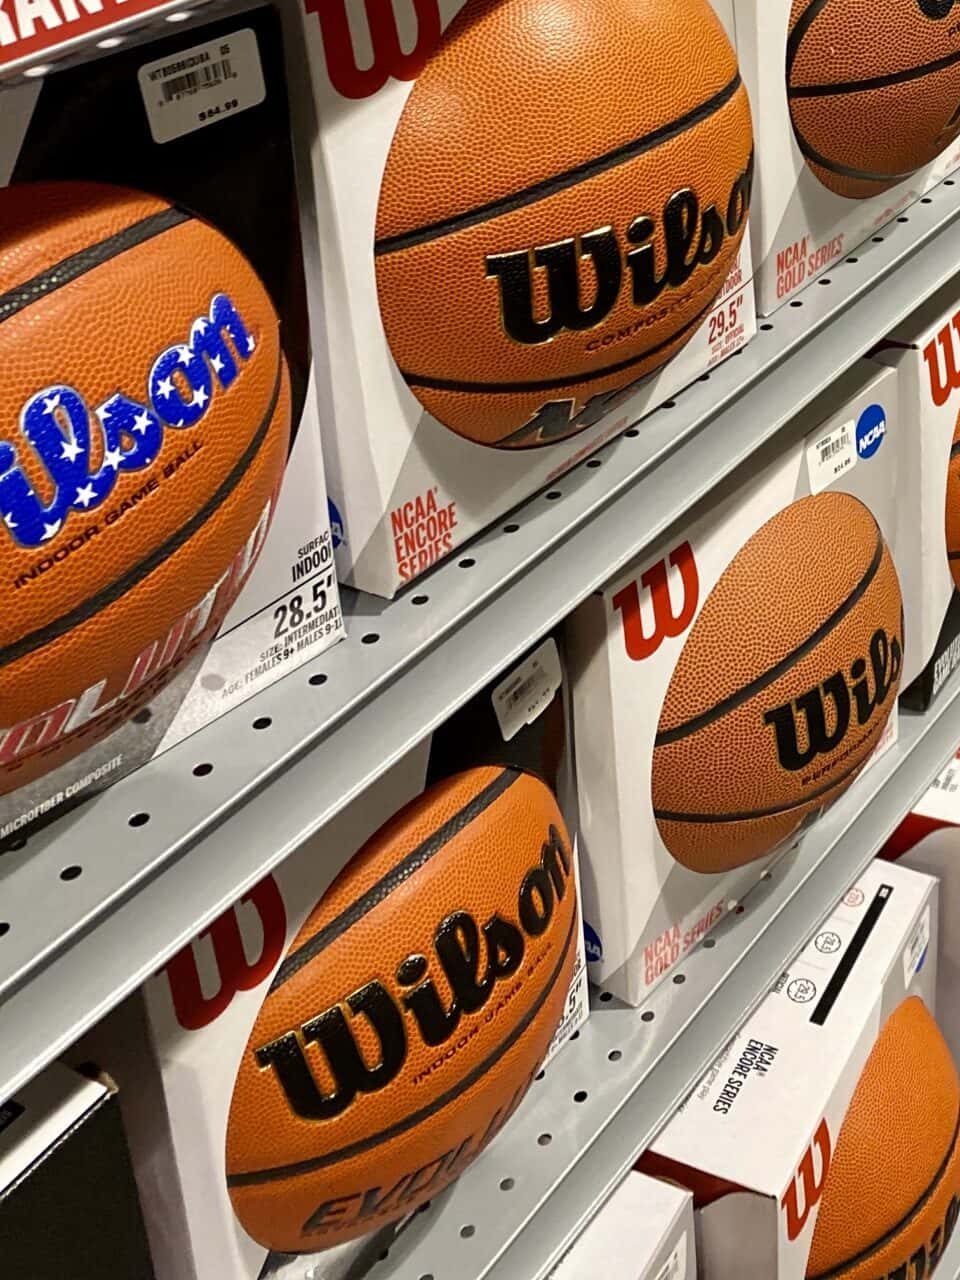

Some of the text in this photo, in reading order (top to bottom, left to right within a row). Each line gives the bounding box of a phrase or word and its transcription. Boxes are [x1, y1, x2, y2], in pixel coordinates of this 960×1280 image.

[775, 233, 845, 299] GOLD SERIES
[776, 233, 810, 274] NCAA
[708, 294, 744, 345] 29.5"
[859, 420, 886, 454] NCAA
[14, 440, 203, 589] INDOOR GAME BALL
[390, 487, 438, 538] NCAA
[394, 503, 458, 564] ENCORE
[221, 680, 244, 700] AGE:
[244, 652, 283, 685] FEMALES
[283, 647, 296, 661] 9+
[296, 628, 324, 652] MALES
[259, 642, 284, 663] SIZE:
[0, 753, 124, 839] MICROFIBER COMPOSITE
[644, 943, 680, 988] GOLD
[411, 1025, 480, 1085] INDOOR
[712, 1038, 764, 1115] ENCORE SERIES
[753, 1044, 779, 1077] NCAA
